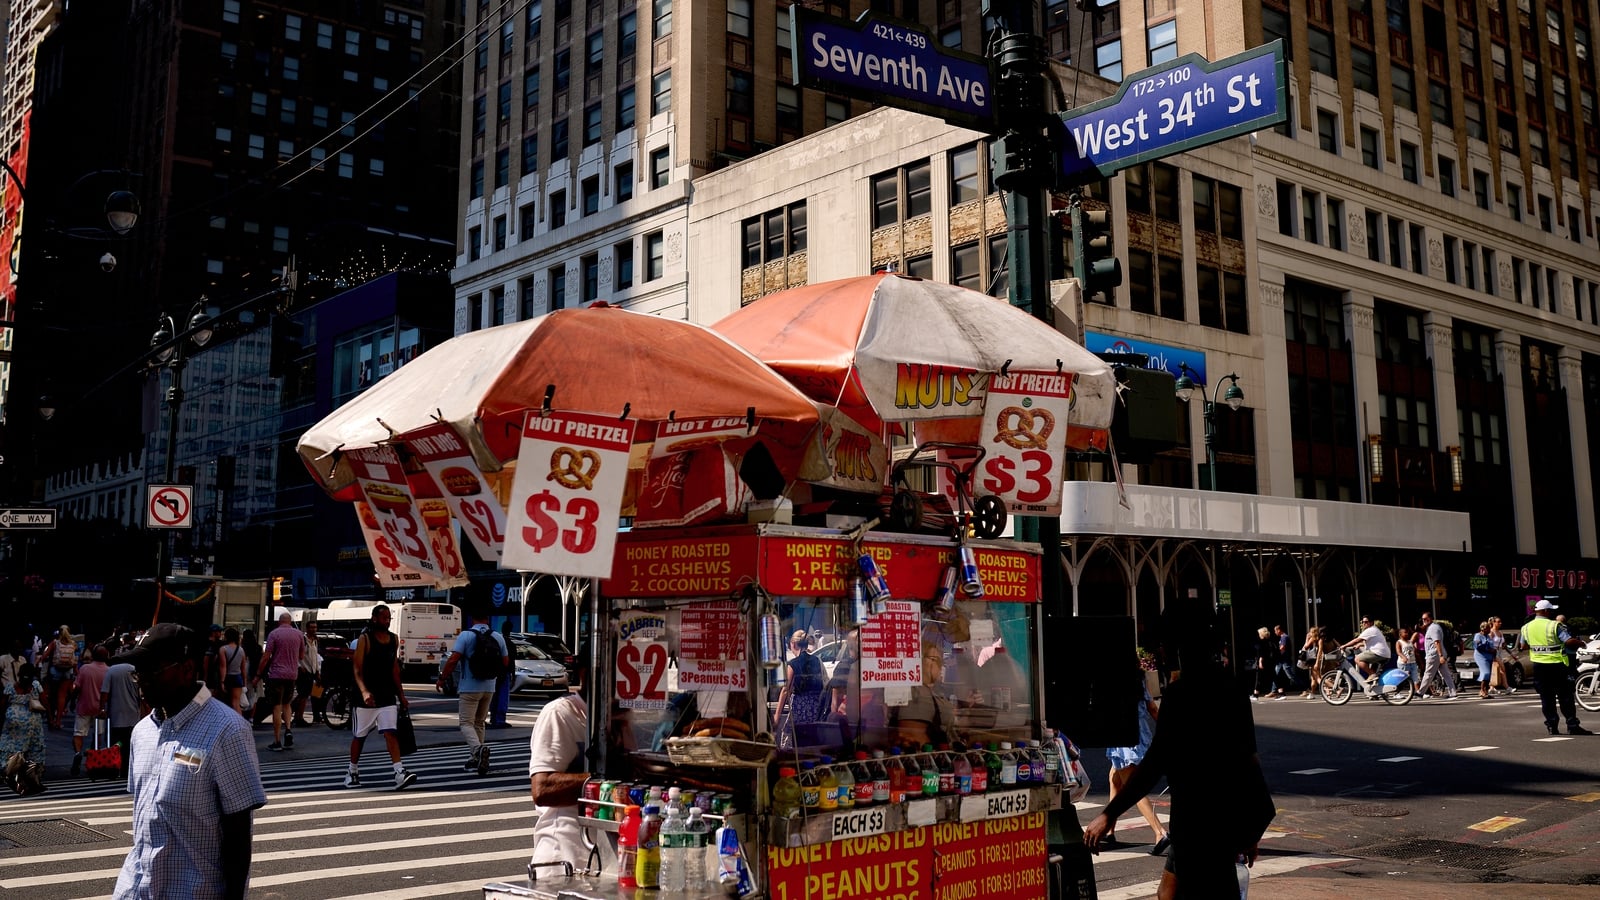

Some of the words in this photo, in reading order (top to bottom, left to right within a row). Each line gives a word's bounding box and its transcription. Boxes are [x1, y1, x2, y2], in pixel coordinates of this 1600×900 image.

[873, 24, 895, 41] 421
[905, 33, 926, 50] 439
[812, 32, 928, 93] Seventh
[937, 64, 985, 107] Ave
[1132, 79, 1155, 98] 172
[1168, 67, 1191, 87] 100
[1073, 107, 1148, 160] West
[1158, 83, 1215, 137] 34th
[1227, 72, 1262, 115] St
[895, 363, 976, 409] NUTS
[994, 373, 1020, 390] HOT
[1019, 373, 1066, 394] PRETZEL
[529, 416, 563, 434] HOT
[565, 421, 629, 444] PRETZEL
[666, 420, 709, 434] HOT
[410, 437, 439, 456] HOT
[430, 432, 462, 452] DOG
[983, 450, 1053, 503] $3
[2, 515, 20, 523] ONE
[27, 515, 47, 523] WAY
[460, 498, 505, 547] $2
[522, 489, 600, 555] $3
[384, 508, 428, 561] $3
[432, 527, 460, 577] $3
[627, 546, 668, 560] HONEY
[672, 543, 730, 559] ROASTED
[786, 543, 832, 558] HONEY
[980, 554, 1027, 569] ROASTED
[632, 565, 645, 577] 1.
[648, 561, 732, 576] CASHEWS
[792, 562, 807, 575] 1.
[1545, 569, 1587, 590] STOP
[630, 580, 644, 592] 2.
[648, 577, 730, 592] COCONUTS
[792, 578, 807, 591] 2.
[886, 602, 911, 610] ROASTED
[620, 618, 665, 640] SABRETT
[617, 640, 667, 700] $2
[697, 661, 726, 672] Special
[862, 670, 907, 682] 3Peanuts
[878, 659, 903, 671] Special
[681, 672, 730, 685] 3Peanuts
[987, 796, 1013, 816] EACH
[1015, 793, 1027, 813] $3
[834, 813, 868, 836] EACH
[869, 811, 883, 833] $3
[933, 822, 980, 847] HONEY
[985, 811, 1045, 836] ROASTED
[767, 841, 833, 870] HONEY
[841, 828, 927, 858] ROASTED
[942, 849, 976, 872] PEANUTS
[980, 848, 984, 865] 1
[986, 844, 1001, 864] FOR
[1002, 842, 1011, 863] $2
[1014, 842, 1020, 859] 2
[1020, 840, 1035, 857] FOR
[1035, 838, 1046, 857] $4
[804, 859, 920, 900] PEANUTS
[942, 880, 977, 900] ALMONDS
[981, 879, 985, 895] 1
[986, 875, 1002, 895] FOR
[1003, 872, 1012, 893] $3
[1016, 873, 1021, 888] 2
[1021, 870, 1036, 888] FOR
[1036, 867, 1045, 887] $5
